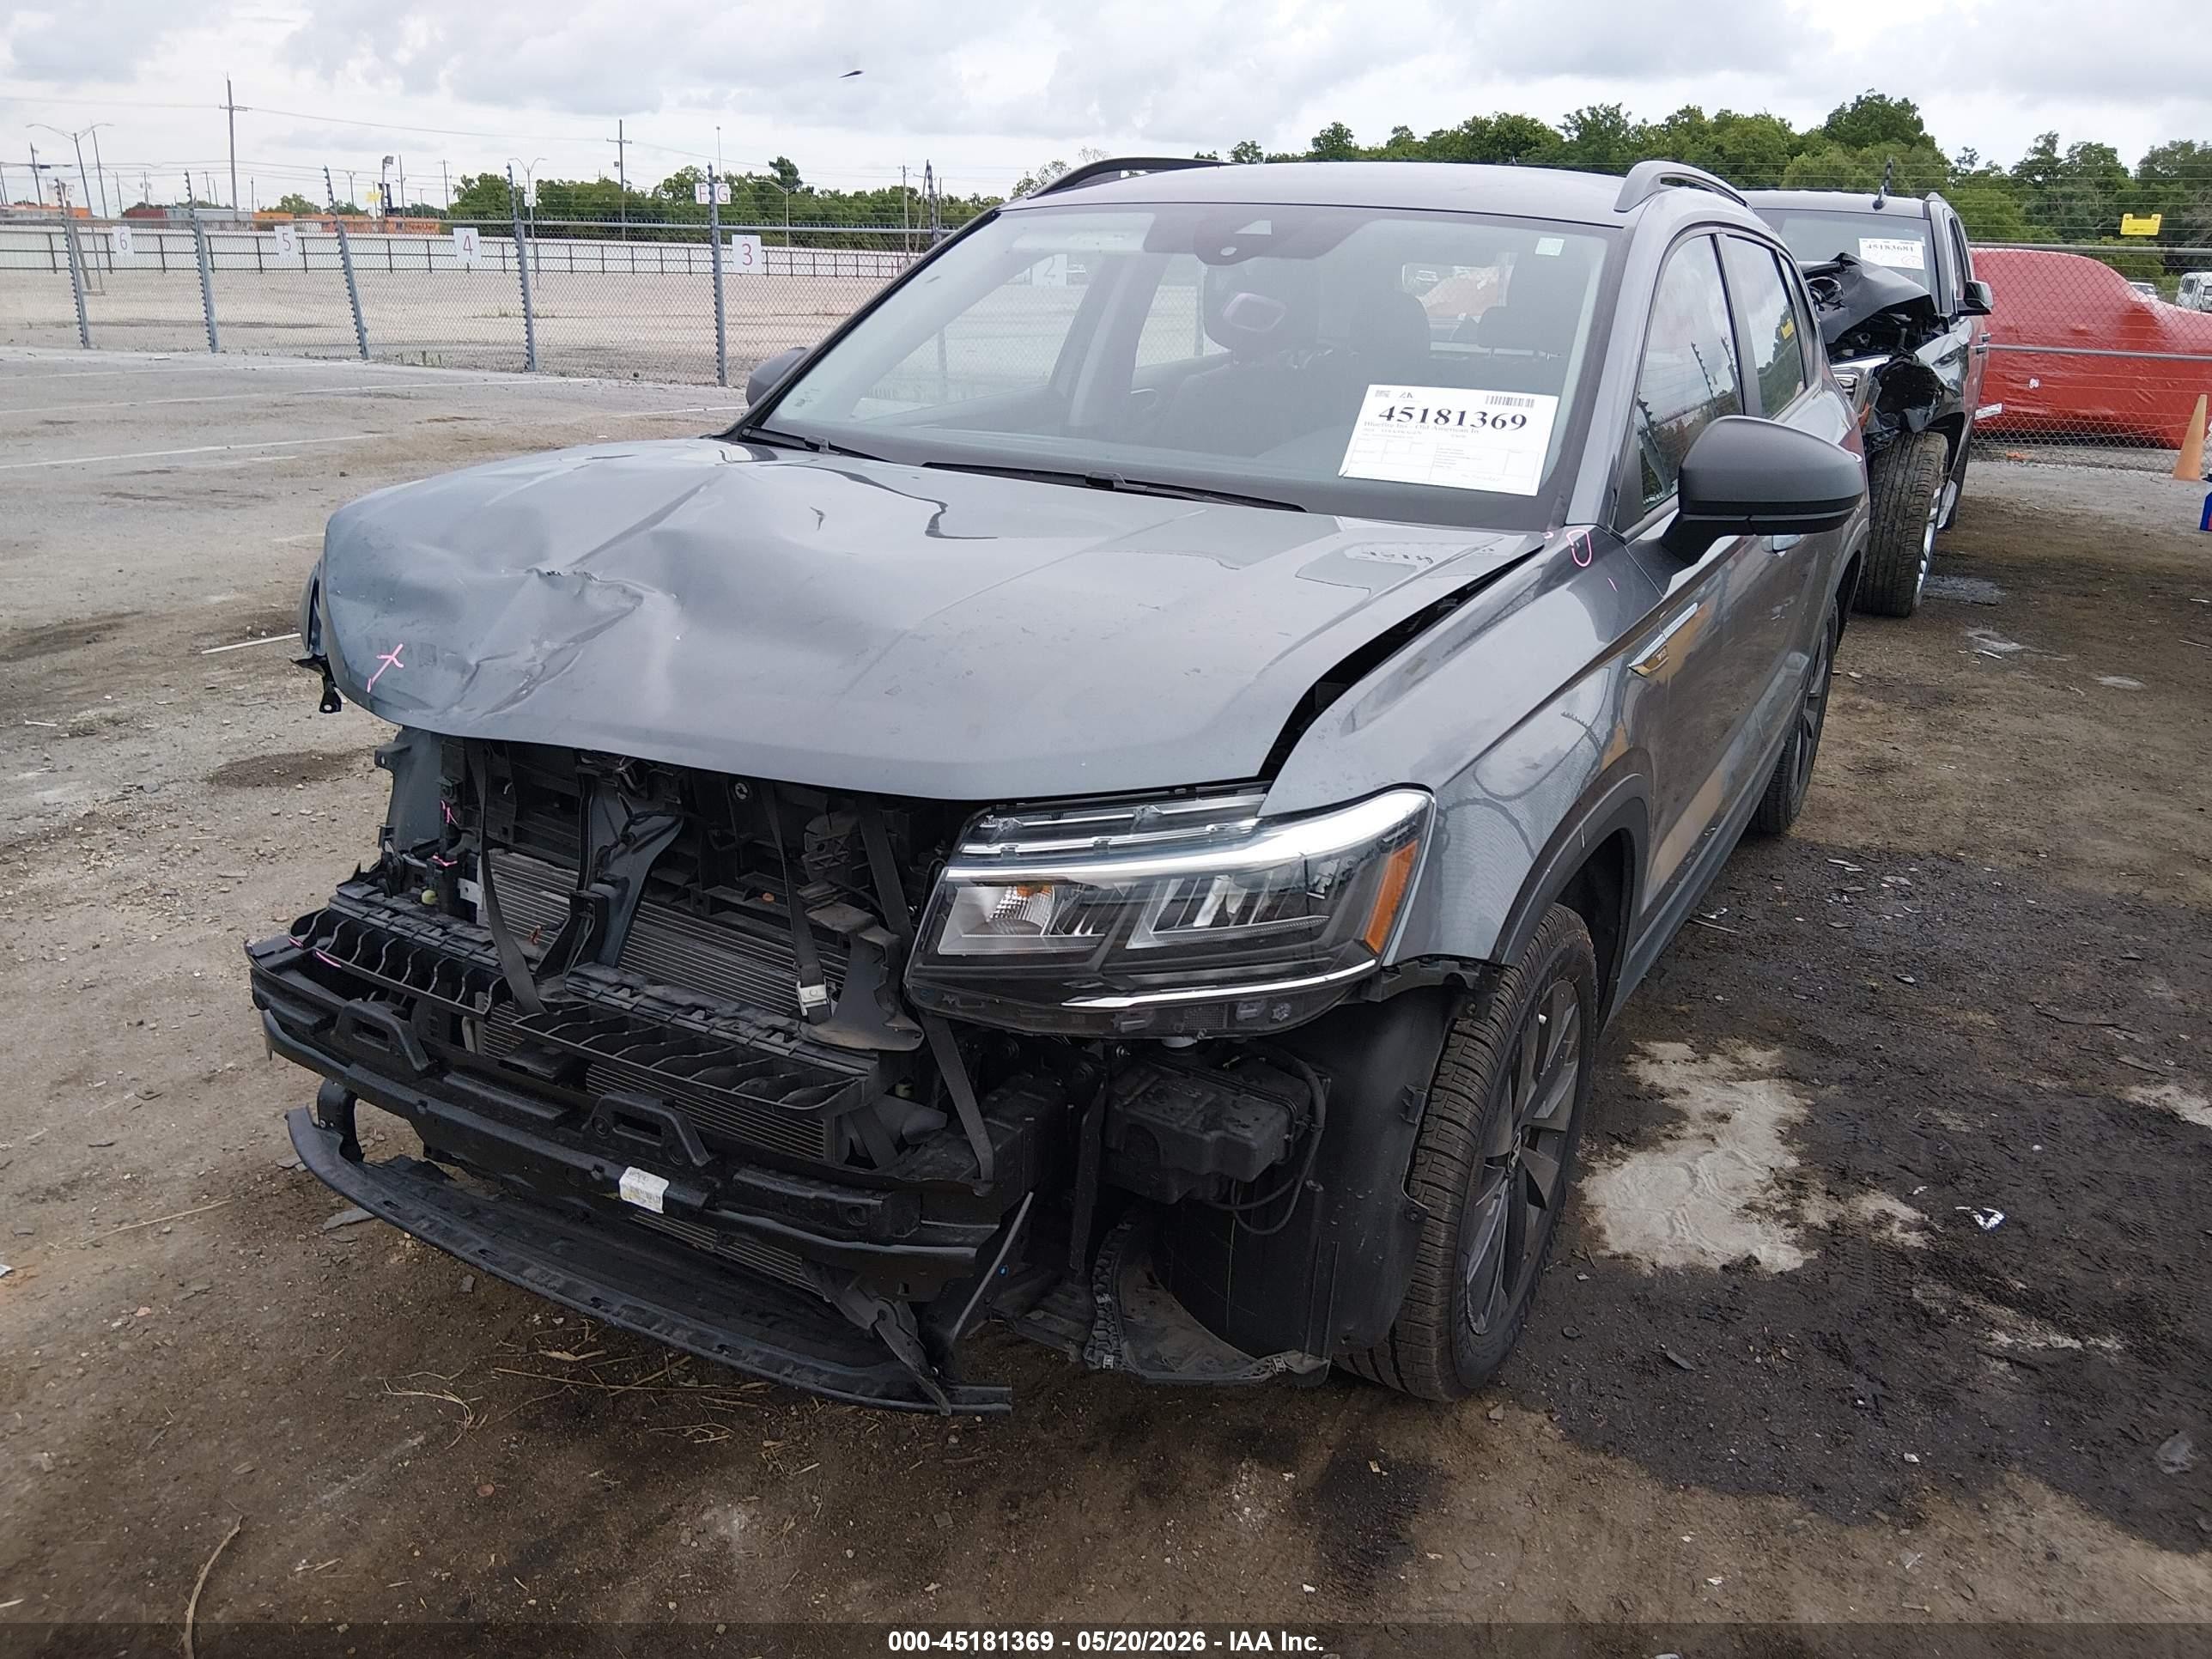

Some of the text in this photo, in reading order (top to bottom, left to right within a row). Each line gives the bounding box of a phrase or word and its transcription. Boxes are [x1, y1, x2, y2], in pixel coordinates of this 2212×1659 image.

[698, 185, 708, 203] F
[717, 185, 729, 203] G
[118, 231, 129, 252] 6
[281, 232, 292, 252] 5
[462, 234, 474, 257] 4
[740, 241, 753, 267] 3
[1378, 405, 1527, 431] 45181369
